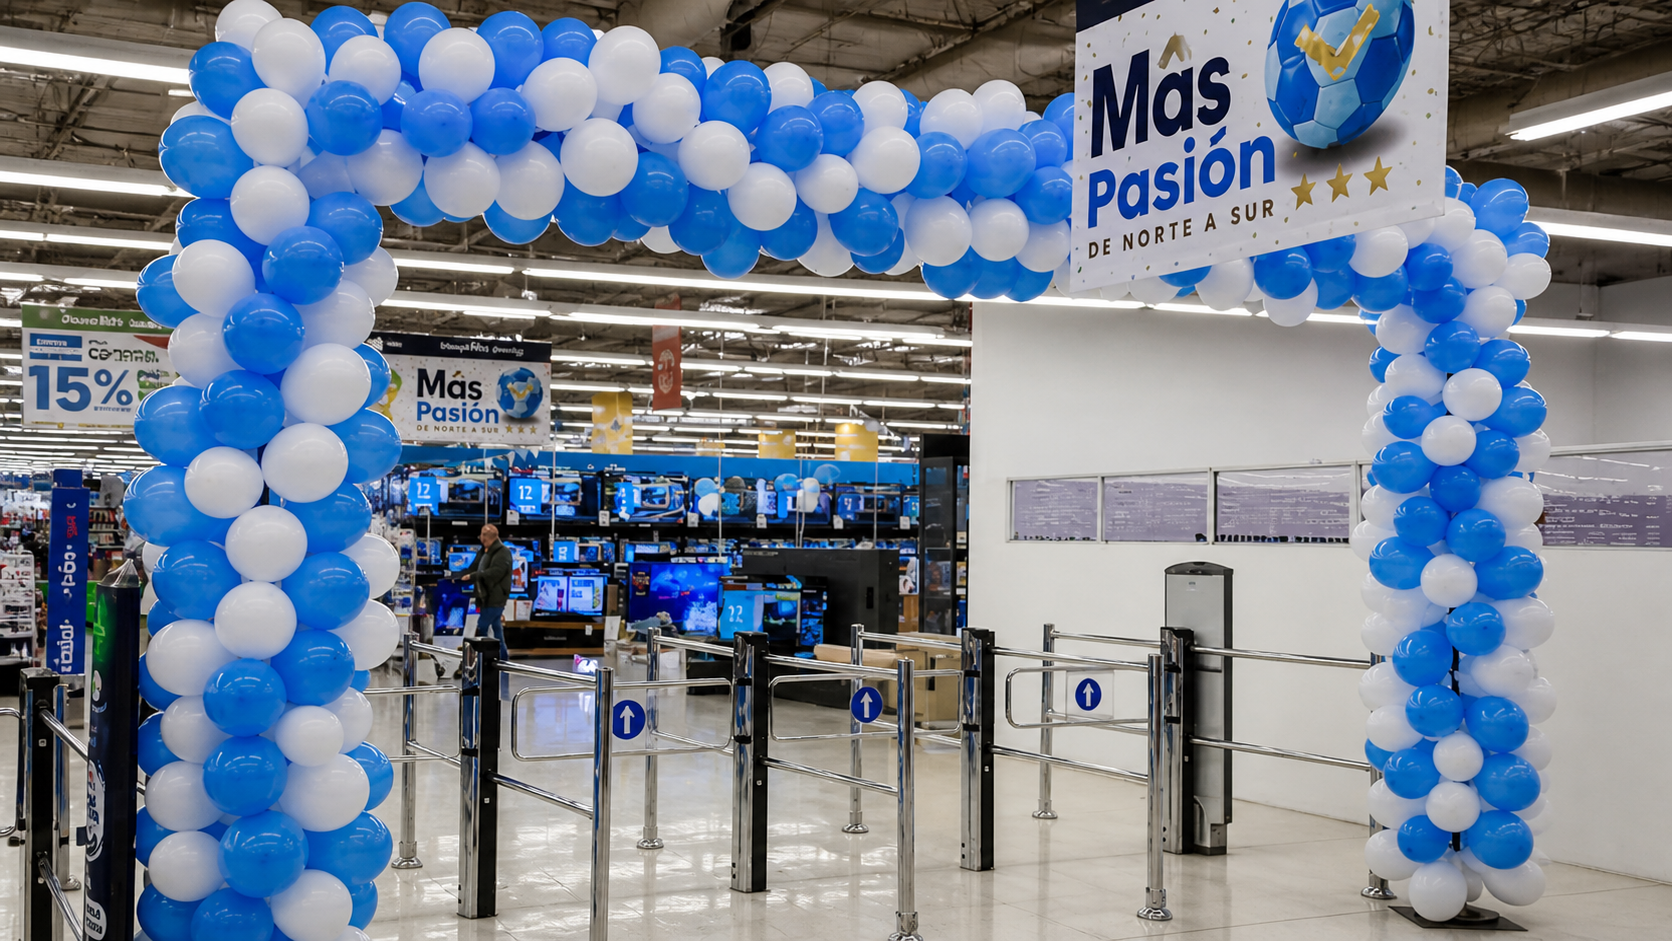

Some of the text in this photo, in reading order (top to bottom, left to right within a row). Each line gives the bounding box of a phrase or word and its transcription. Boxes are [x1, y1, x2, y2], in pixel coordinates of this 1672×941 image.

[1087, 126, 1276, 229] Pasión
[1088, 198, 1275, 259] DE NORTE A SUR
[28, 365, 133, 412] 15%
[416, 401, 499, 424] Pasión
[416, 424, 429, 432] DE
[434, 425, 467, 433] NORTE
[518, 485, 533, 500] 12
